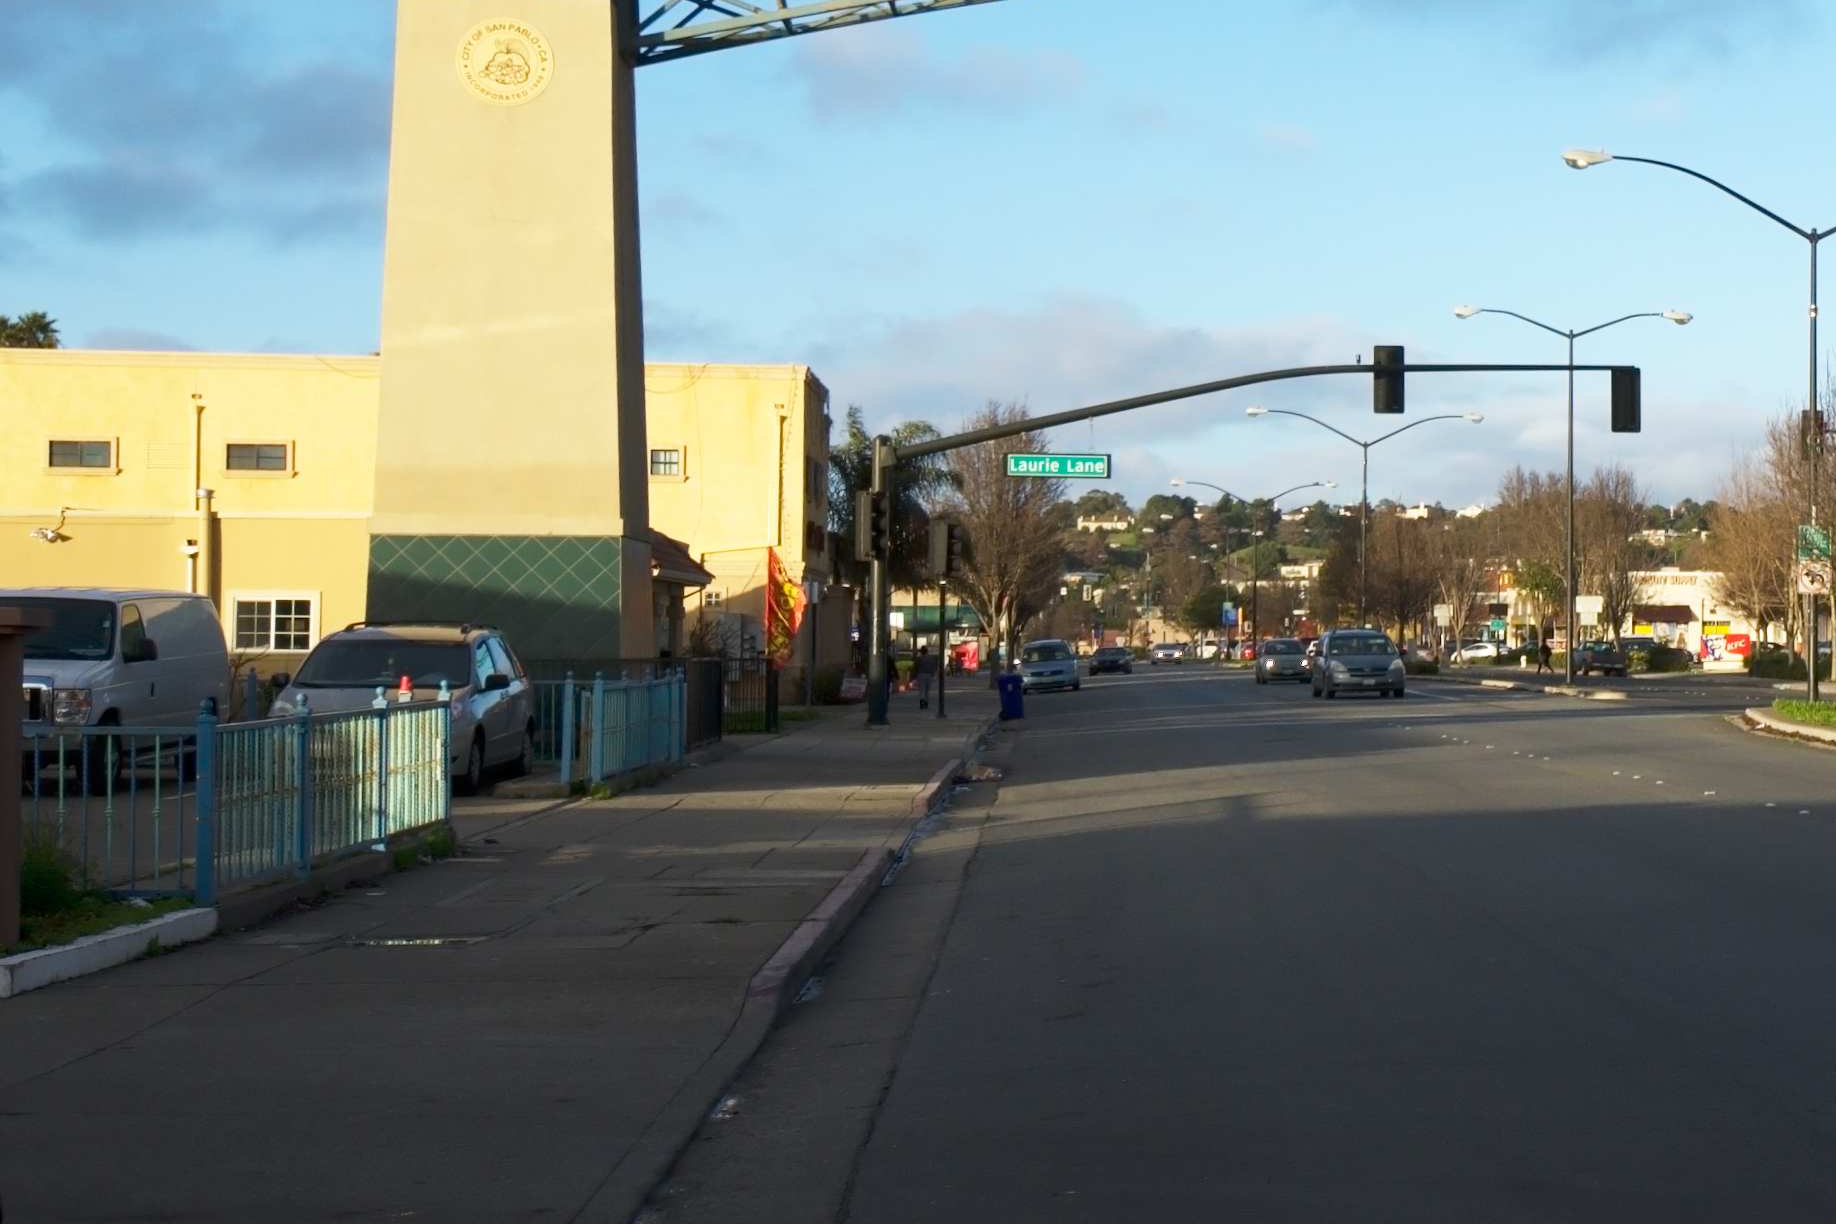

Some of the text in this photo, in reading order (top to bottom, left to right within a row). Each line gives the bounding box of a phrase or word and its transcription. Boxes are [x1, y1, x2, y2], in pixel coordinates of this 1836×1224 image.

[461, 23, 548, 63] CITY OF SAN PABLO CA
[465, 71, 528, 101] INCORPORATED
[1010, 458, 1105, 474] Laurie Lane
[1671, 576, 1698, 586] SUPPLY
[1726, 639, 1746, 651] KFC
